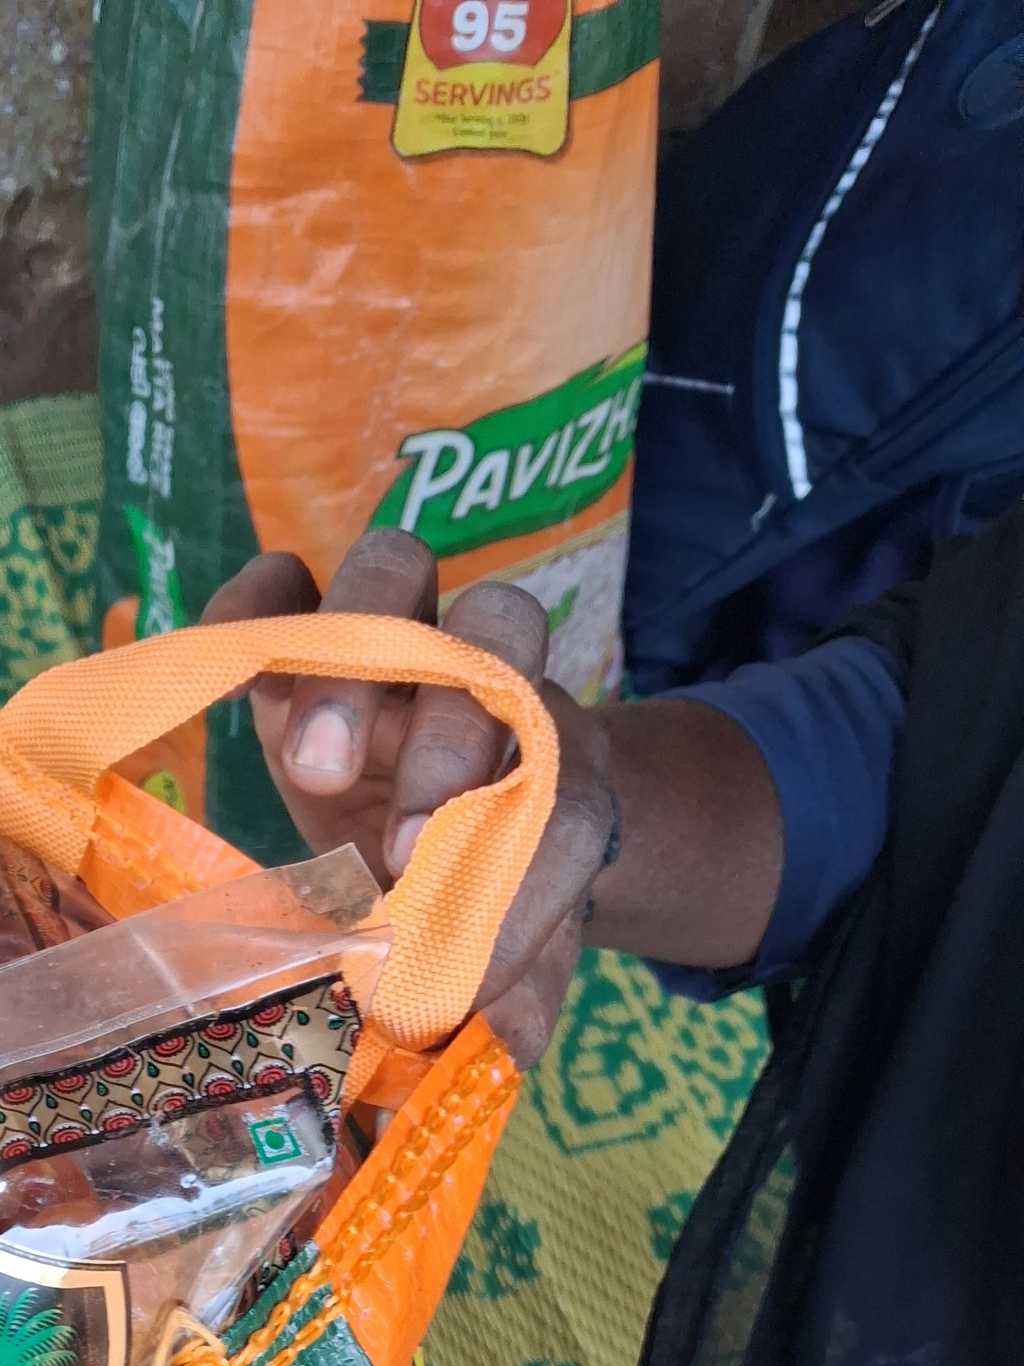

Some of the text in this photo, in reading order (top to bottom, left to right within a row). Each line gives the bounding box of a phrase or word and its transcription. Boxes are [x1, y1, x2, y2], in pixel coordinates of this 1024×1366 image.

[451, 0, 528, 52] 95
[415, 75, 552, 106] SERVINGS
[397, 376, 643, 533] PAVIZH
